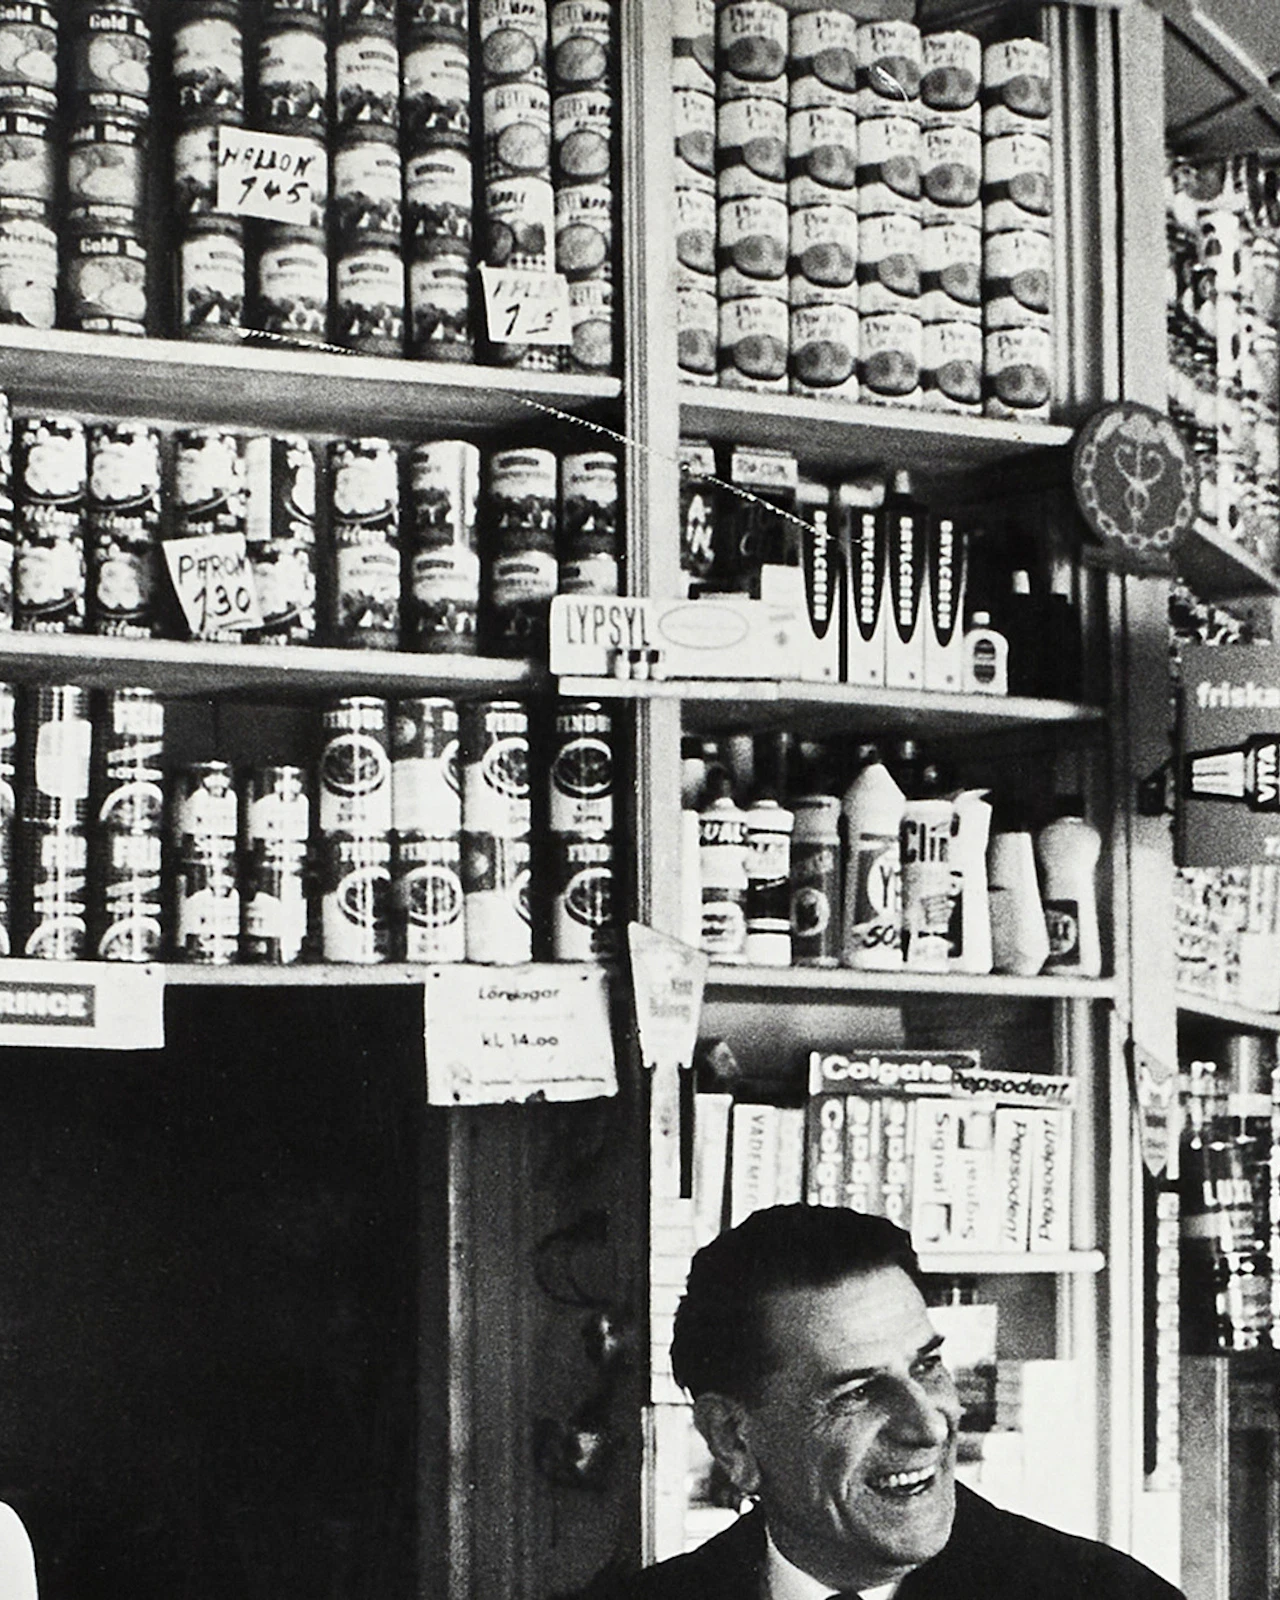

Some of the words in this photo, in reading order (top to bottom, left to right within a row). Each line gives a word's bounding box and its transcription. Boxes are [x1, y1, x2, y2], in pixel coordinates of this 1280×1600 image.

[88, 13, 128, 32] Gold
[566, 603, 650, 647] LYPSYL
[1256, 743, 1278, 804] VITA
[822, 1054, 953, 1086] Colgate
